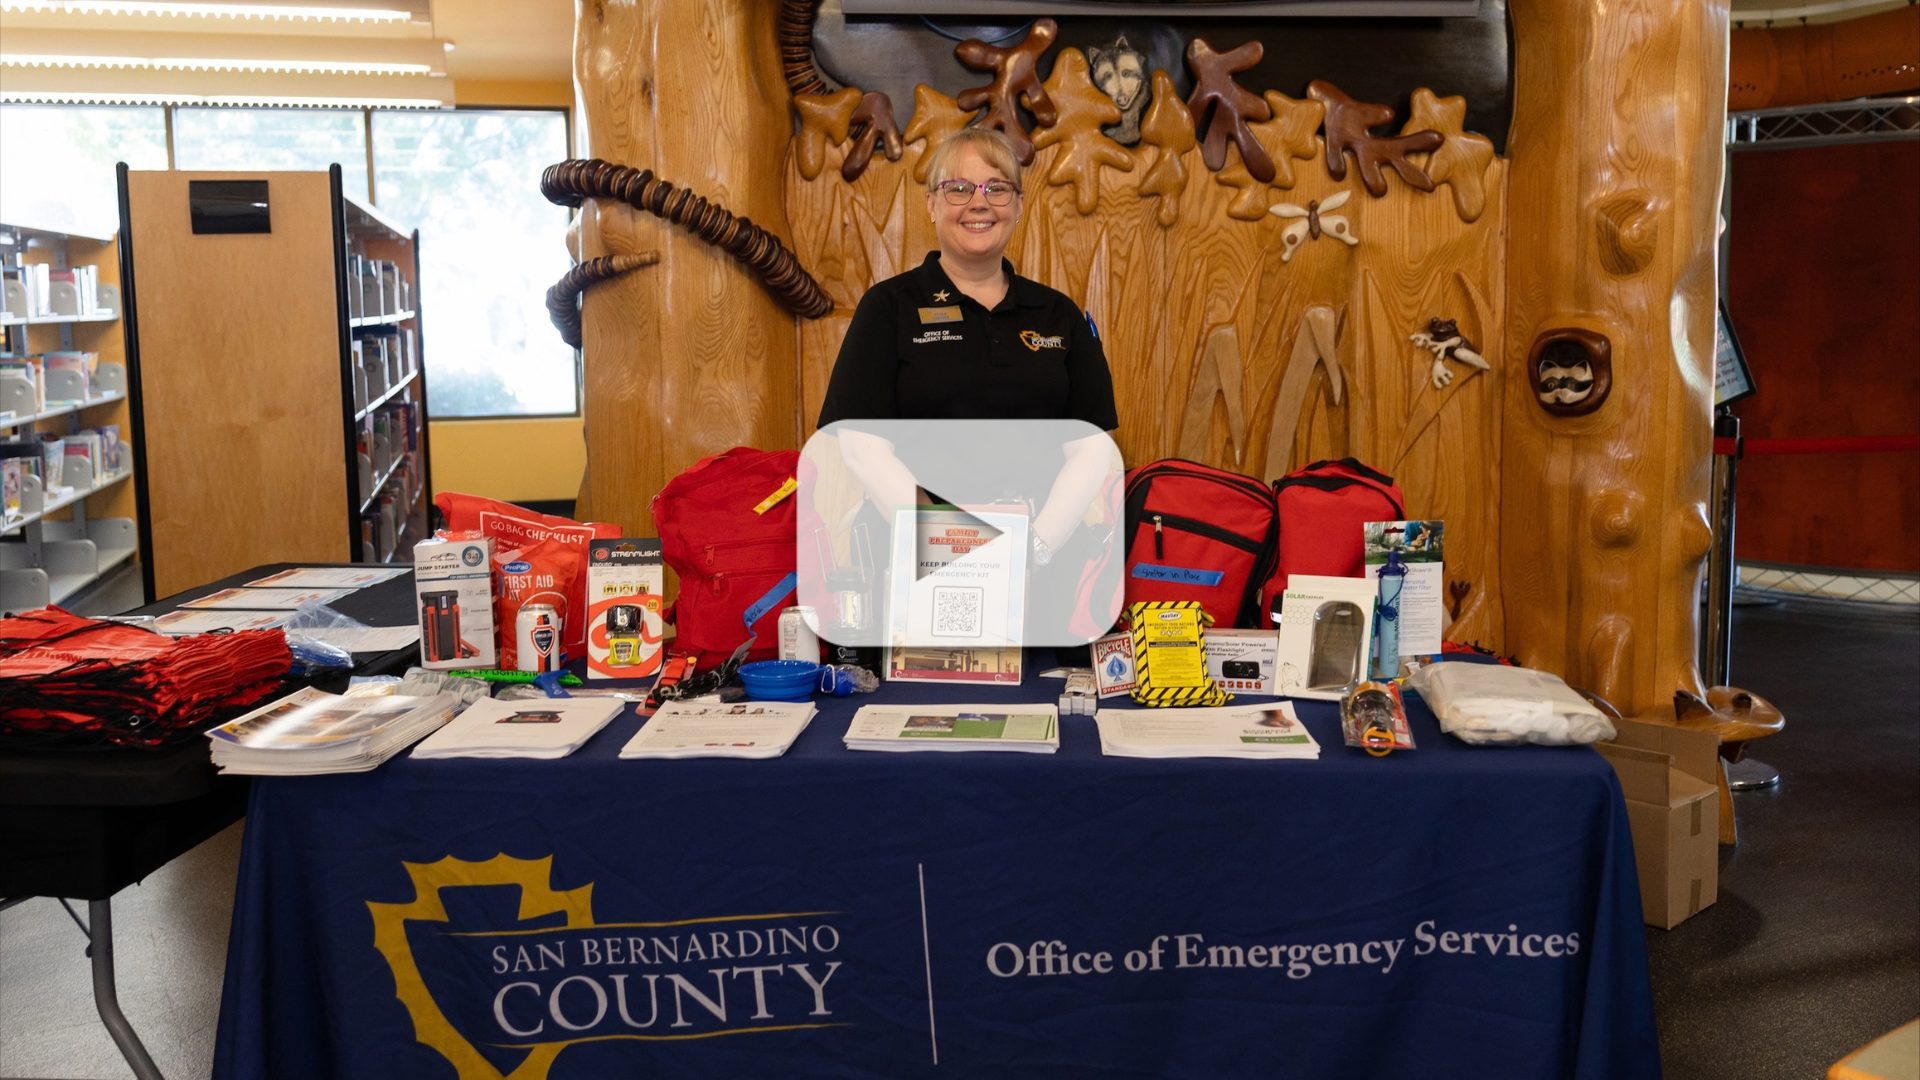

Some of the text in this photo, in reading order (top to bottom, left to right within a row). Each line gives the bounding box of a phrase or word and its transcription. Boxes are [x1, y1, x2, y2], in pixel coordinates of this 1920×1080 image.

[490, 521, 505, 531] GO
[506, 524, 524, 536] BAG
[941, 561, 978, 569] BUILDING
[536, 574, 554, 588] AID
[1098, 639, 1131, 662] BICYCLE
[492, 924, 841, 975] SAN BERNARDINO
[986, 919, 1581, 979] Office of Emergency Services
[492, 961, 842, 1036] COUNTY
